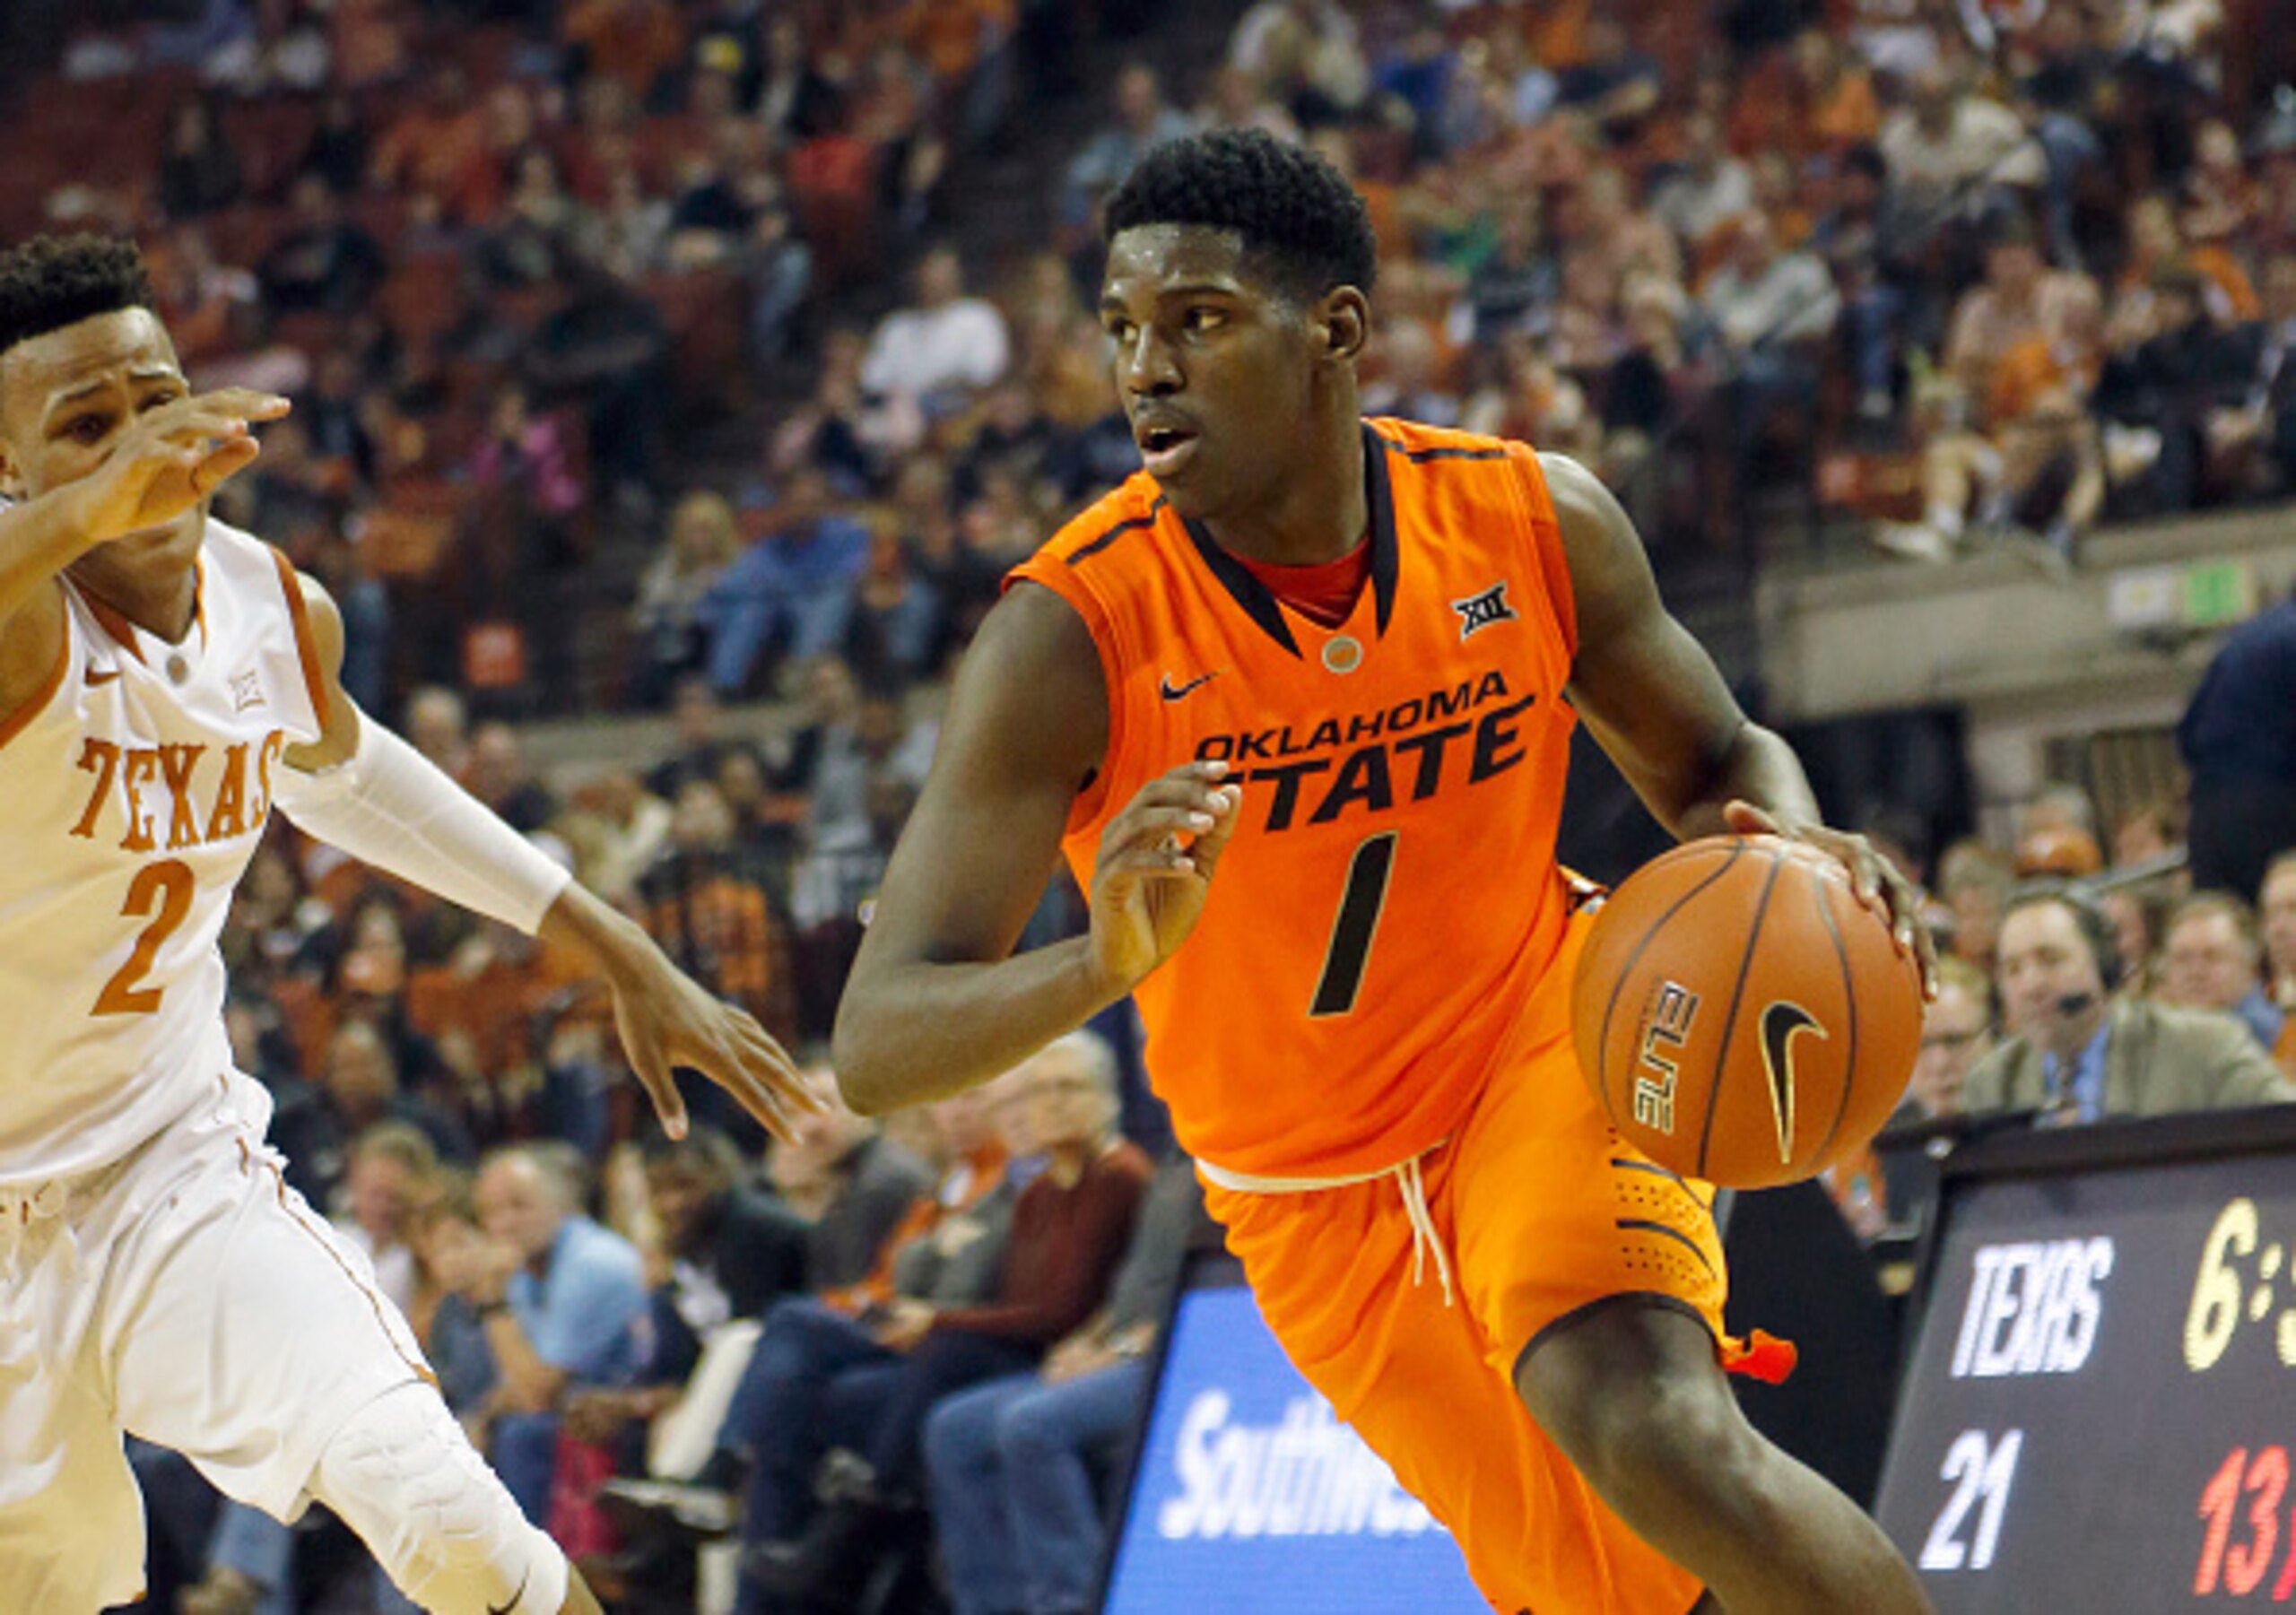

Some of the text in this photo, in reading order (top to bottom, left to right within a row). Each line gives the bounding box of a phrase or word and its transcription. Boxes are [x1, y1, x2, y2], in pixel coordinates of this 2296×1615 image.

[1453, 582, 1516, 638] XII
[1193, 671, 1509, 762] OKLAHOMA
[1213, 694, 1535, 832] TATE
[69, 730, 283, 851] TEXAS
[90, 858, 195, 1016] 2
[1309, 829, 1398, 1019] 1
[1635, 979, 1700, 1136] ELITE
[1950, 1235, 2115, 1378] TEXAS
[2183, 1196, 2296, 1372] 6:
[1160, 1388, 1448, 1539] Southwe
[1918, 1428, 2024, 1571] 21
